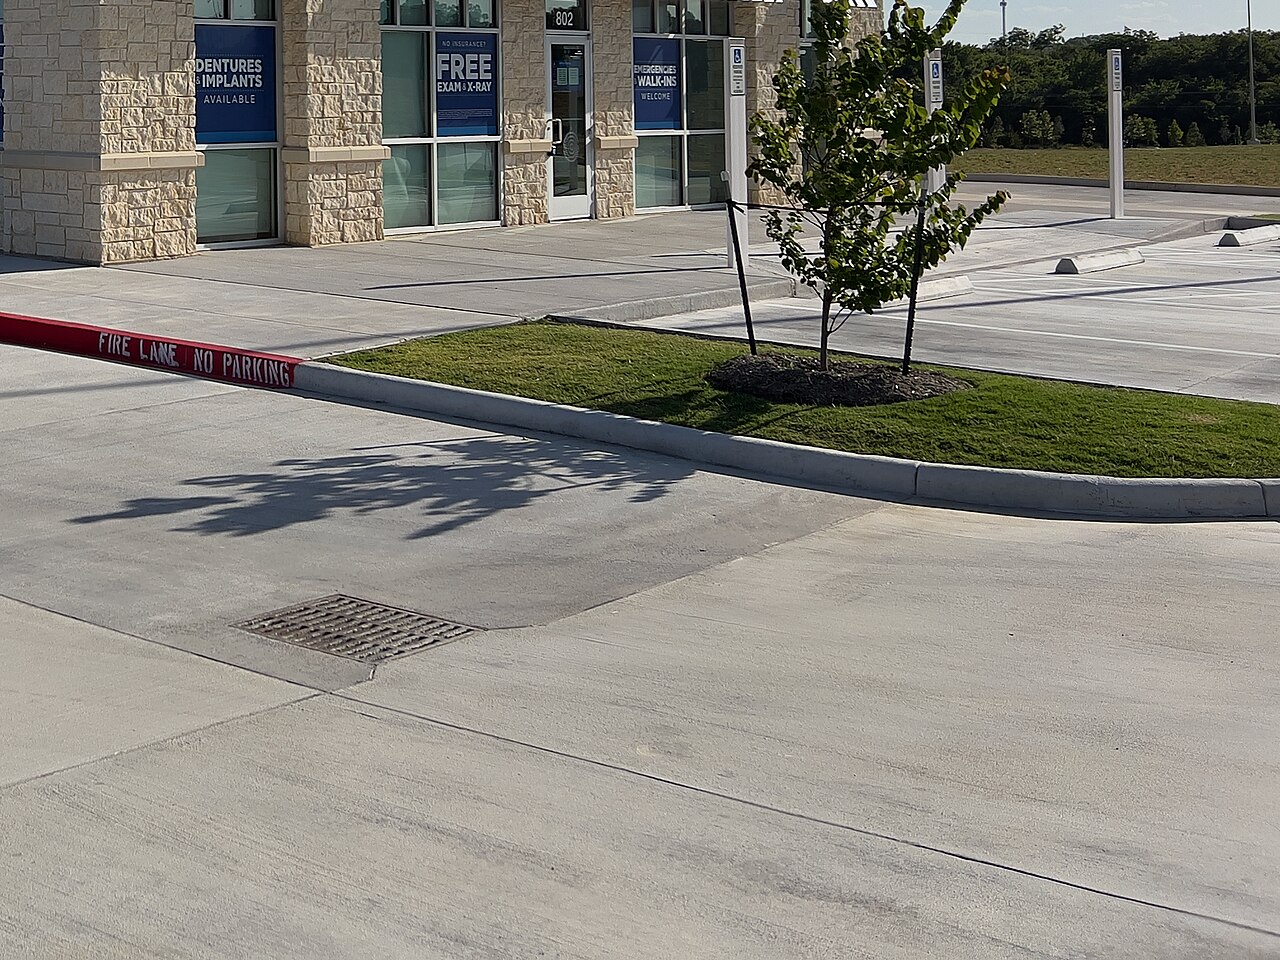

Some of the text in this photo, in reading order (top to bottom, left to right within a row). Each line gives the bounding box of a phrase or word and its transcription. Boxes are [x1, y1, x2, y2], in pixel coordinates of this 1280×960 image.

[556, 11, 573, 26] 802
[195, 58, 262, 73] DENTURES
[437, 53, 492, 80] FREE
[202, 74, 263, 88] IMPLANTS
[437, 81, 461, 92] EXAM
[467, 81, 492, 92] X-RAY
[637, 75, 677, 87] WALK-INS
[203, 94, 256, 104] AVAILABLE
[640, 92, 670, 100] WELCOME
[98, 332, 290, 388] FIRE LANE NO PARKING
